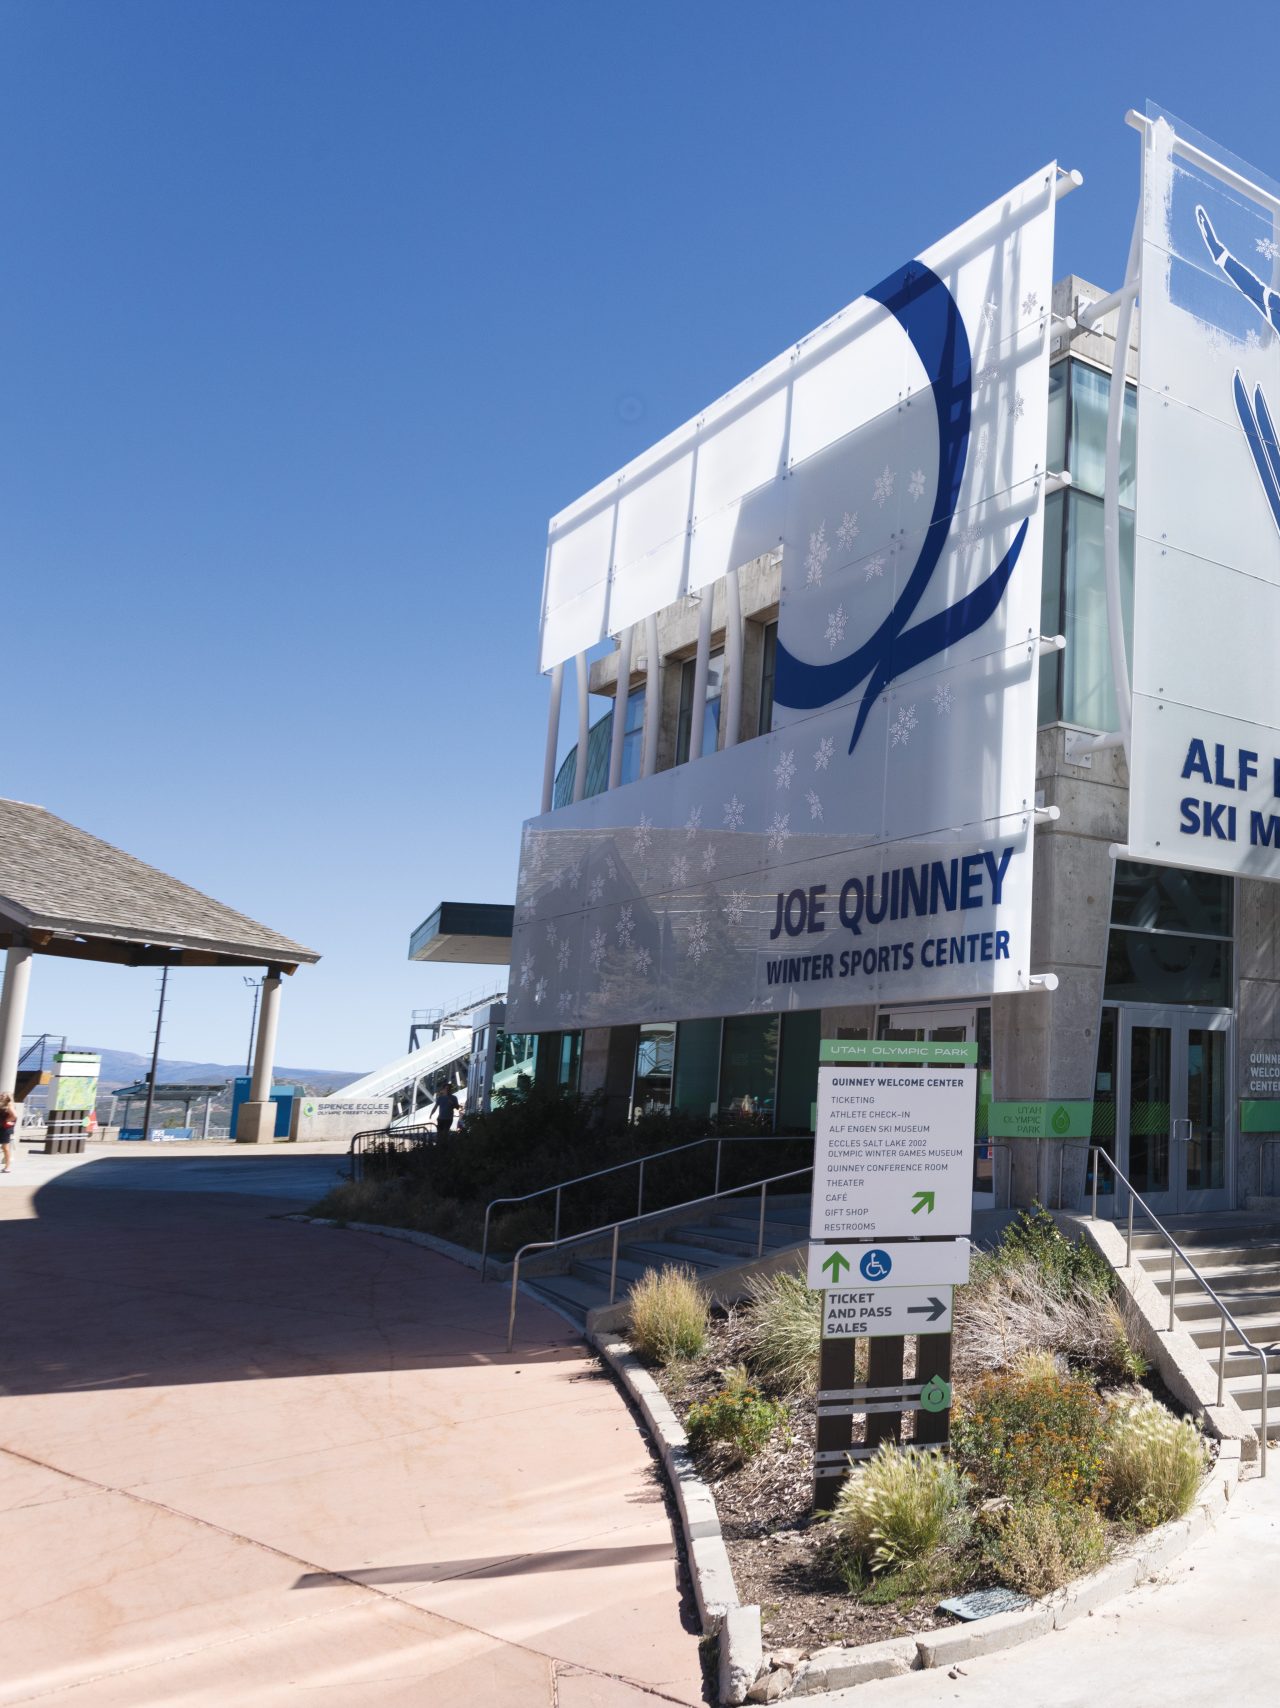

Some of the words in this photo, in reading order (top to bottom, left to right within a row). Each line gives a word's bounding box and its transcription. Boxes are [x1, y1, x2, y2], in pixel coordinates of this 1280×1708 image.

[1181, 738, 1258, 791] ALF
[1180, 797, 1237, 841] SKI
[770, 884, 826, 940] JOE
[838, 846, 1014, 935] QUINNEY
[766, 953, 833, 985] WINTER
[839, 942, 914, 978] SPORTS
[920, 930, 1010, 968] CENTER
[831, 1046, 866, 1055] UTAH
[872, 1047, 929, 1056] OLYMPIC
[935, 1048, 969, 1056] PARK
[832, 1079, 874, 1087] QUINNEY
[878, 1079, 925, 1087] WELCOME
[927, 1079, 964, 1087] CENTER
[830, 1125, 845, 1133] ALF
[827, 1179, 864, 1187] THEATER
[824, 1223, 876, 1231] RESTROOMS
[829, 1293, 875, 1304] TICKET
[828, 1309, 856, 1319] AND
[860, 1307, 892, 1317] PASS
[827, 1323, 867, 1334] SALES
